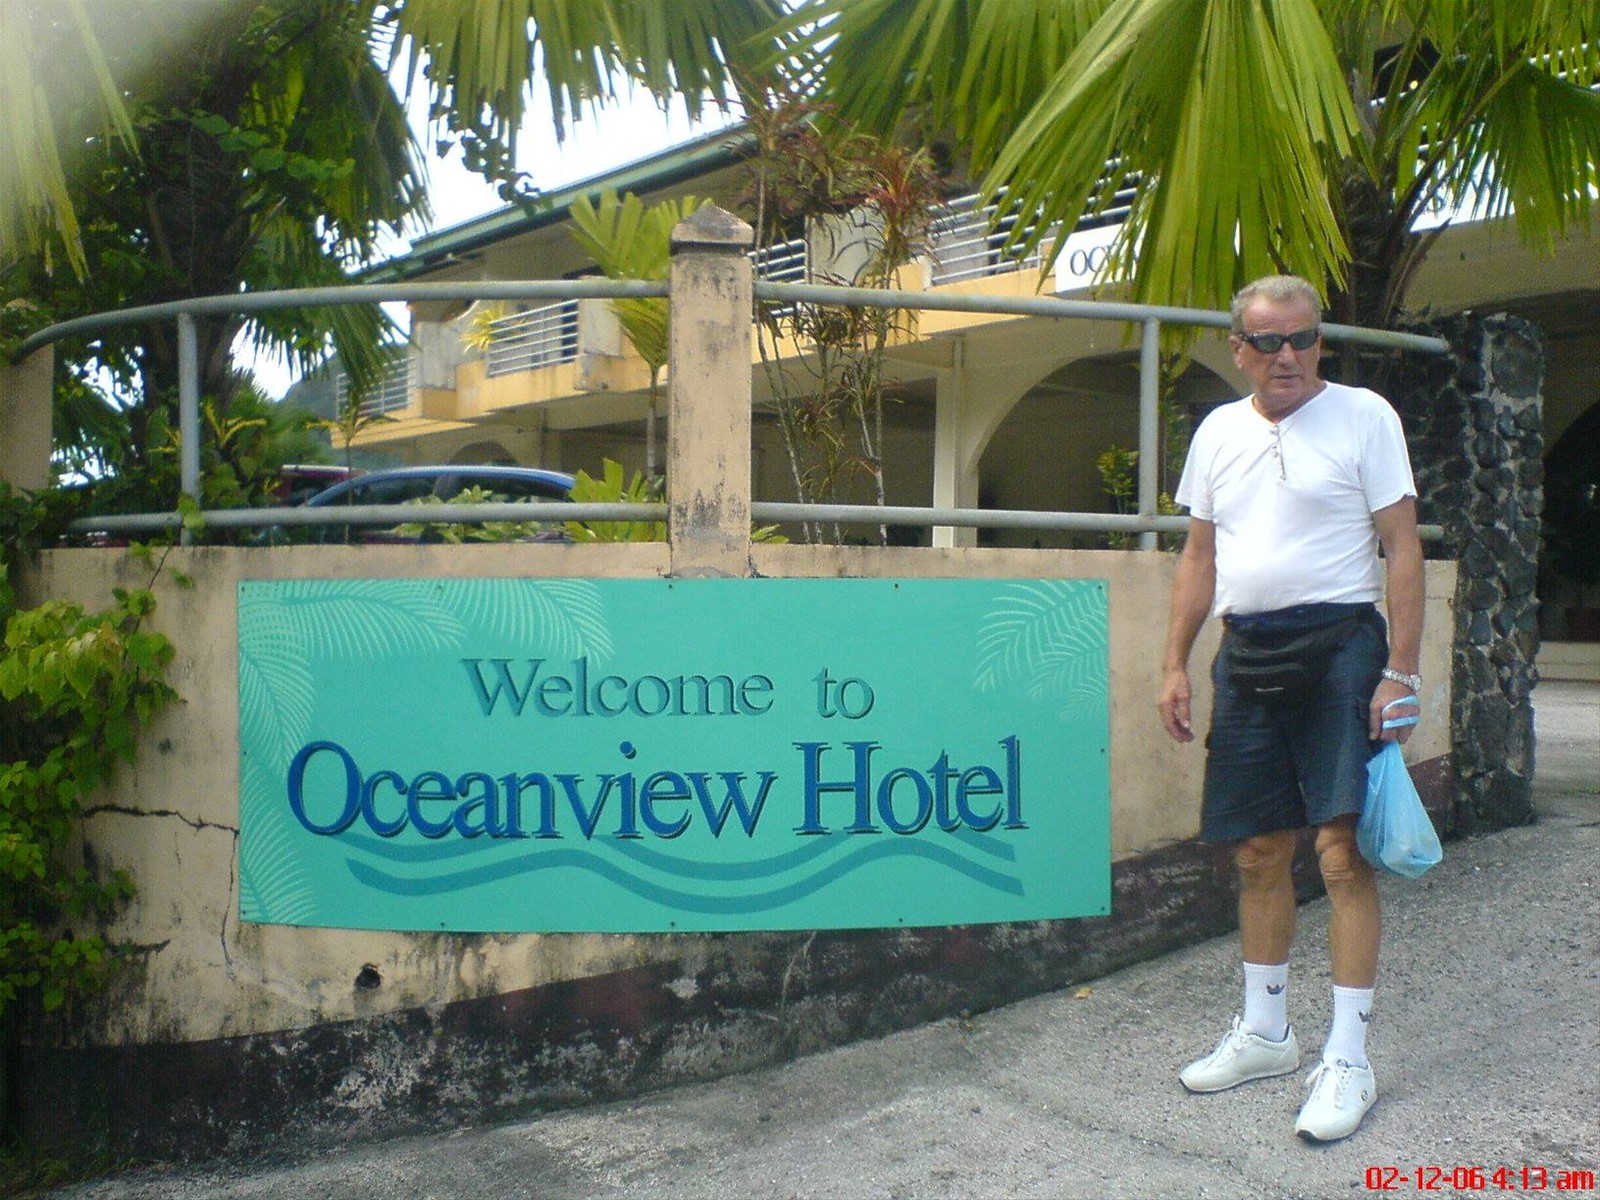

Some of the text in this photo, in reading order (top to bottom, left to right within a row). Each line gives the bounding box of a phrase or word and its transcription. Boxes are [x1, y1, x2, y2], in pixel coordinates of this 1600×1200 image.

[461, 656, 875, 720] Welcome to
[287, 734, 1029, 841] Oceanview Hotel
